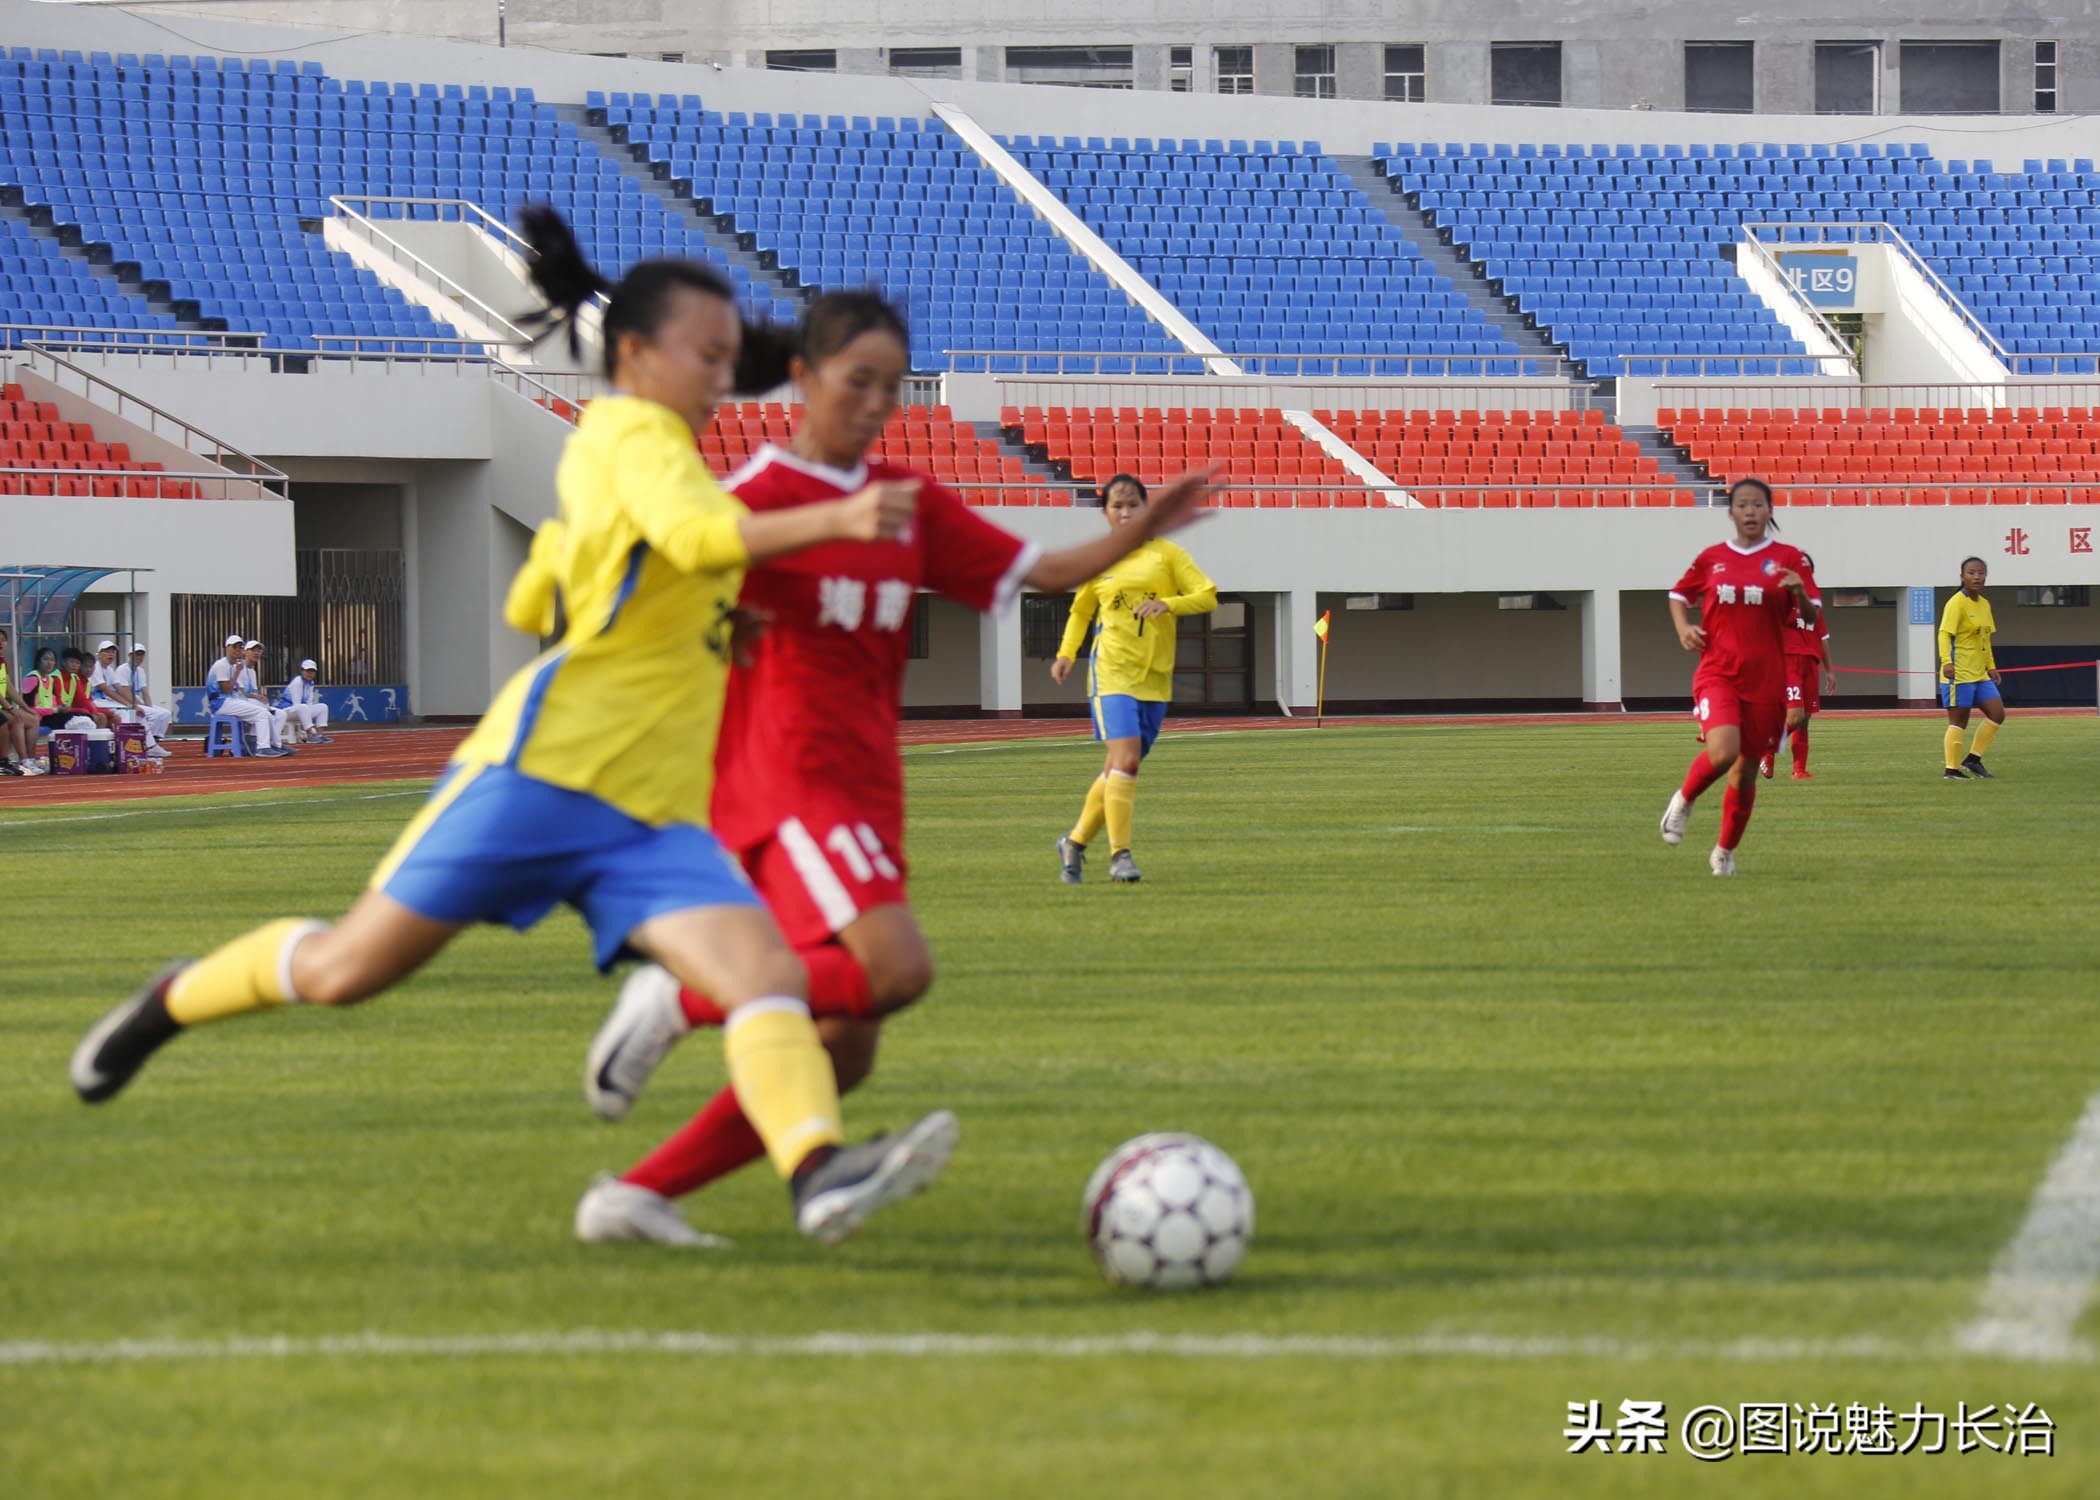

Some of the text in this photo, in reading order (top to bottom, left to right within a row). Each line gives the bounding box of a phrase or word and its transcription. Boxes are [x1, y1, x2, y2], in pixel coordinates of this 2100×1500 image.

[2004, 527, 2093, 555] 北区
[1717, 584, 1763, 605] 海南
[1786, 686, 1801, 701] 32
